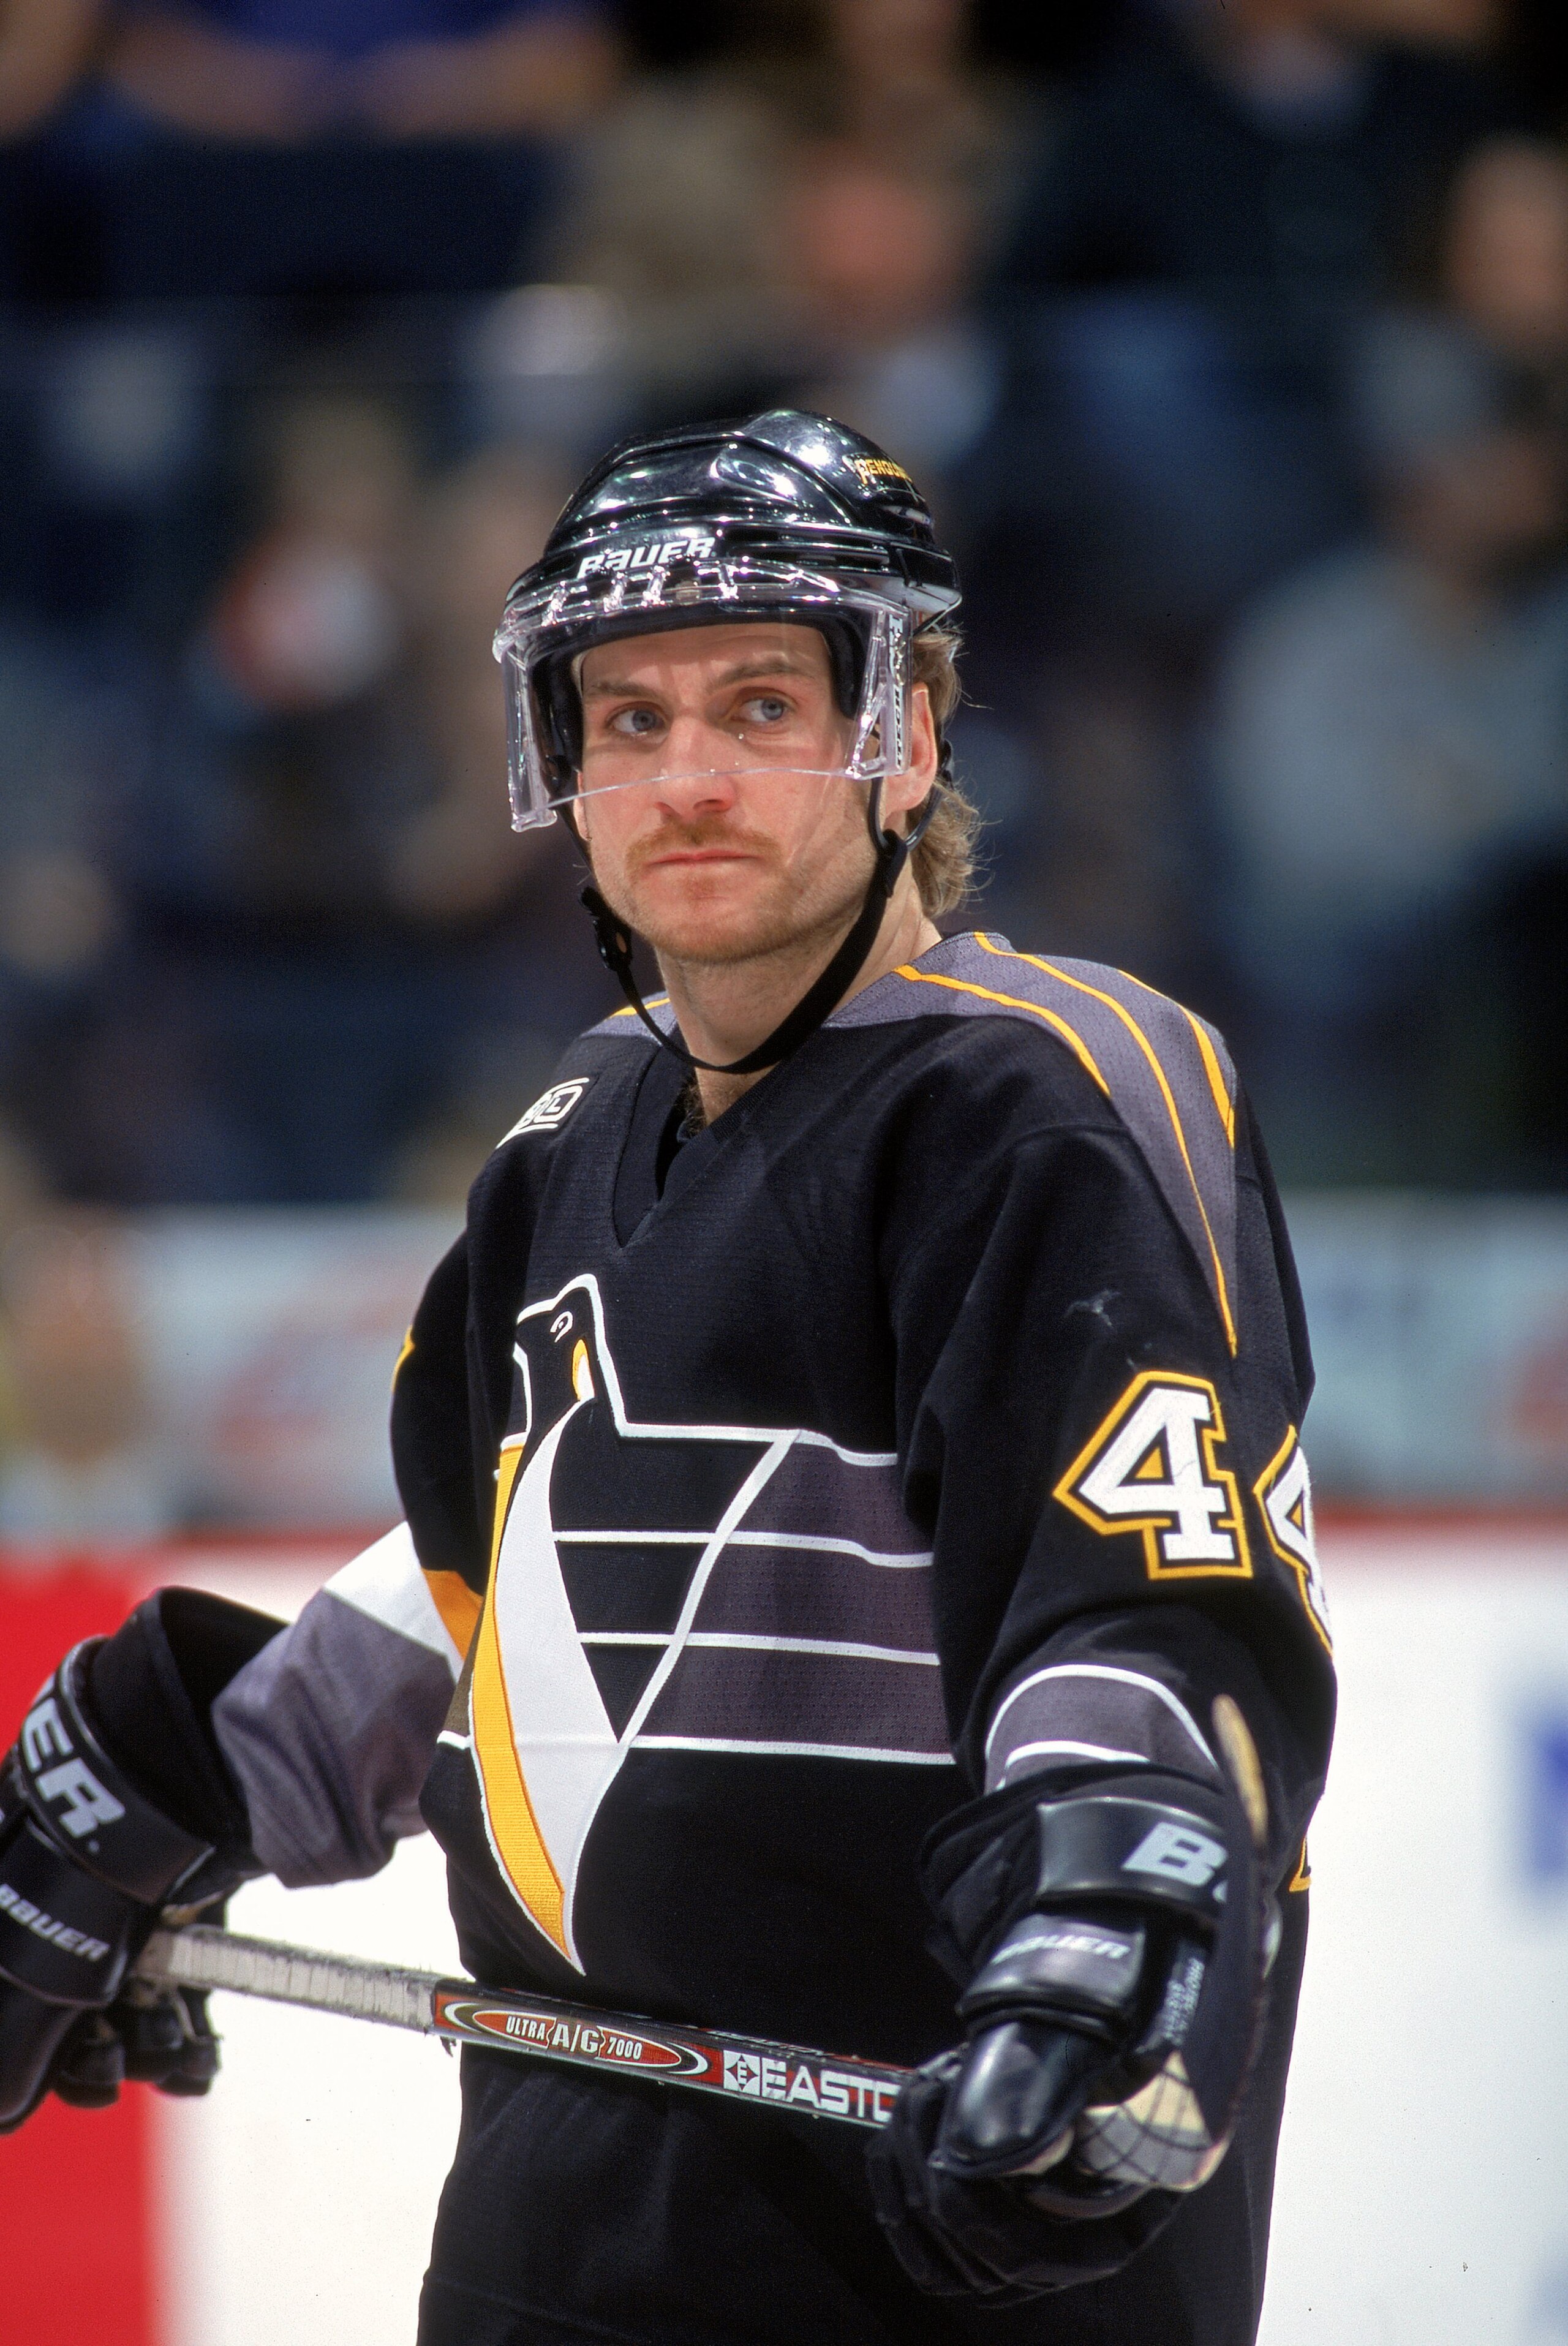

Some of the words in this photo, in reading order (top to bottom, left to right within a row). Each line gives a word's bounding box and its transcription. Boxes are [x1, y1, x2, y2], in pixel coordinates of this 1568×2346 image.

[506, 2016, 546, 2040] ULTRA
[551, 2023, 599, 2053] A/G
[606, 2037, 643, 2061] 7000
